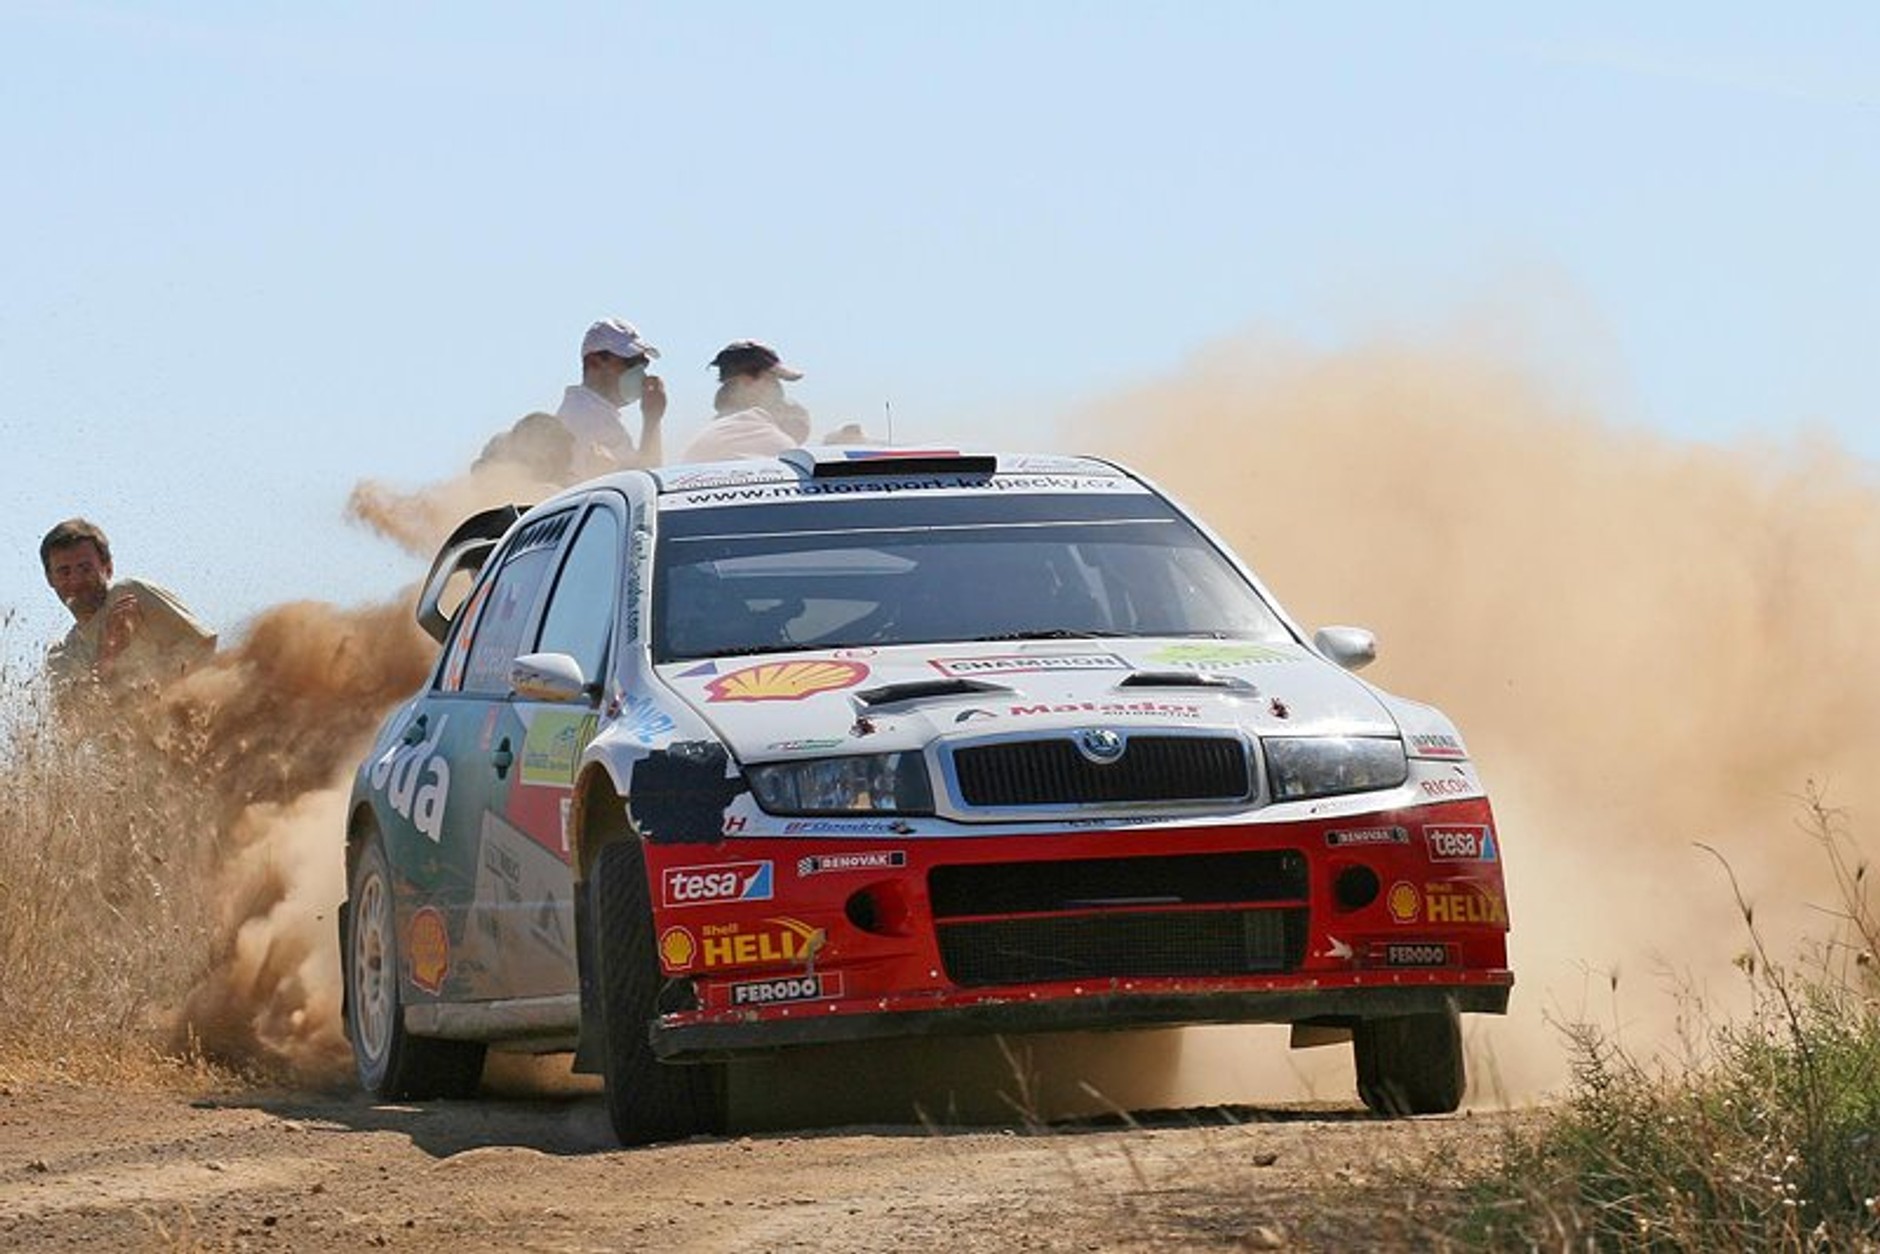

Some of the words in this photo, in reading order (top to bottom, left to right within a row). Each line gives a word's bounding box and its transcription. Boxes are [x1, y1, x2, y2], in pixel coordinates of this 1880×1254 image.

[951, 656, 1118, 673] CHAMPION
[1010, 701, 1201, 717] Matador
[1431, 829, 1477, 856] tesa
[822, 853, 888, 869] RENOVAK
[670, 871, 737, 900] tesa
[1425, 888, 1506, 923] HELIX
[702, 922, 739, 937] Shell
[1388, 946, 1445, 964] FERODO
[735, 978, 817, 1004] FERODO
